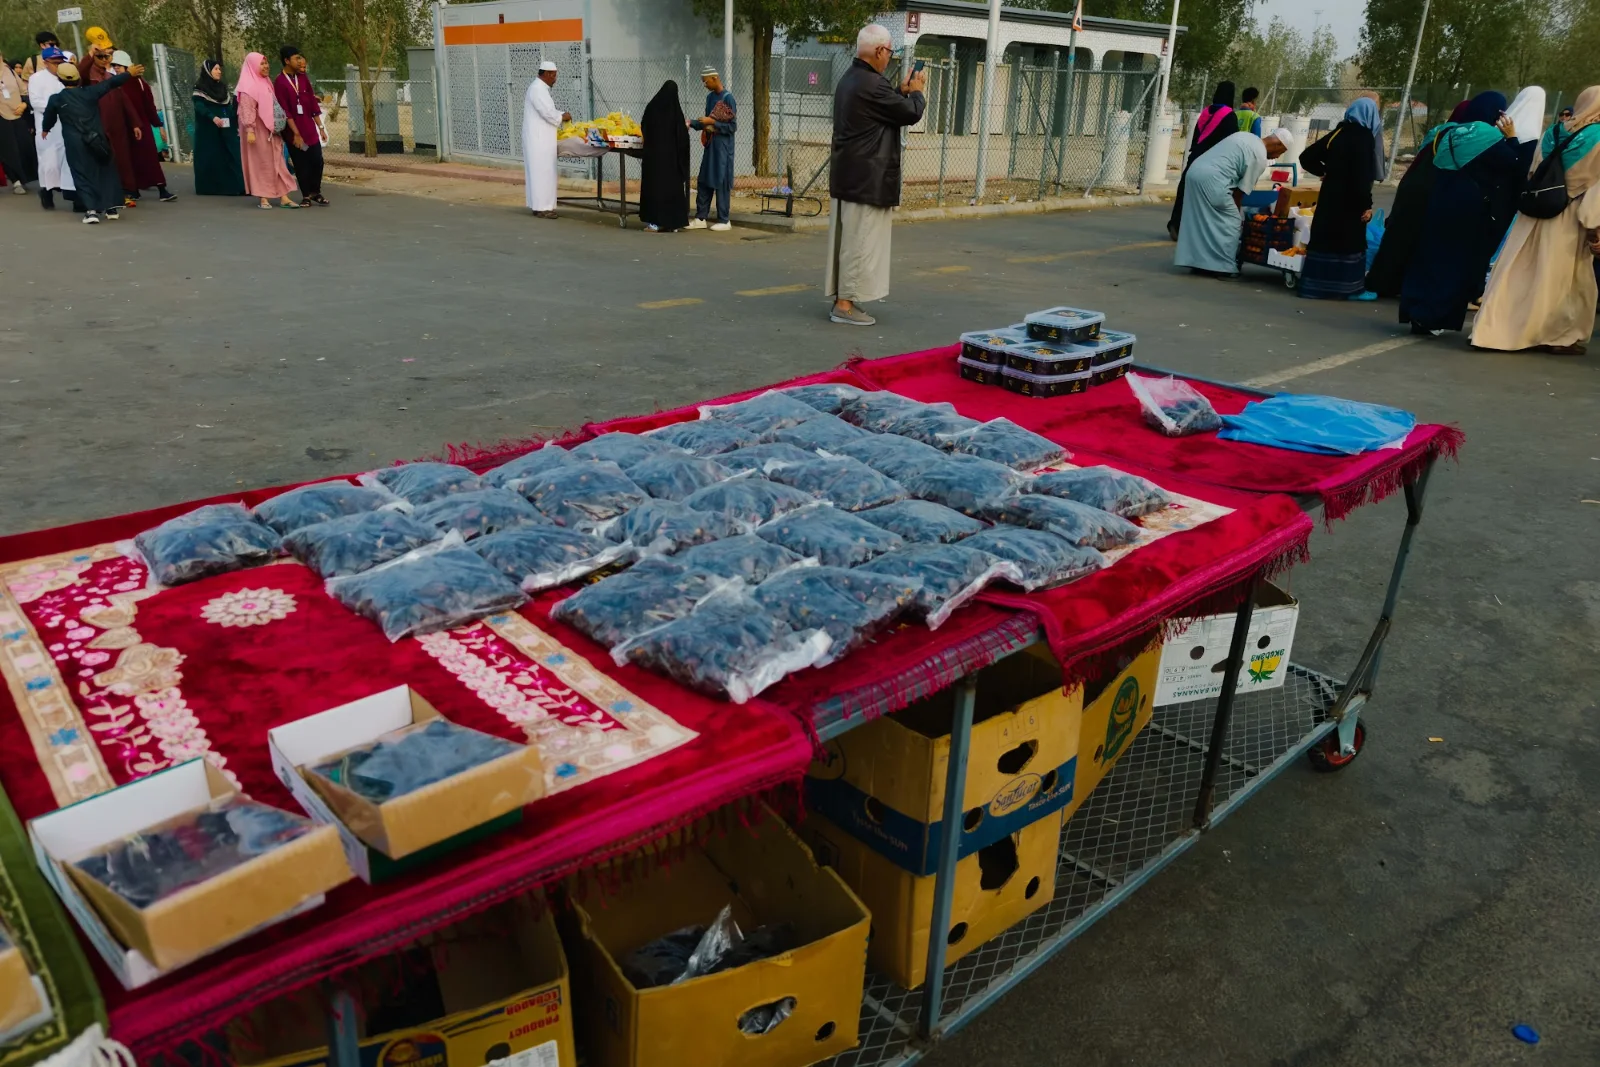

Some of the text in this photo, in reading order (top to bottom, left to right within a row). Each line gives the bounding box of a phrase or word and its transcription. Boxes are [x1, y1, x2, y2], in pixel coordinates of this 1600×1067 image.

[1172, 687, 1210, 698] BANANAS
[1003, 715, 1035, 737] 4 6
[993, 780, 1039, 812] SanLucar
[506, 991, 558, 1015] ECUADOR
[546, 1002, 558, 1014] OF
[509, 1015, 559, 1039] PRODUCT
